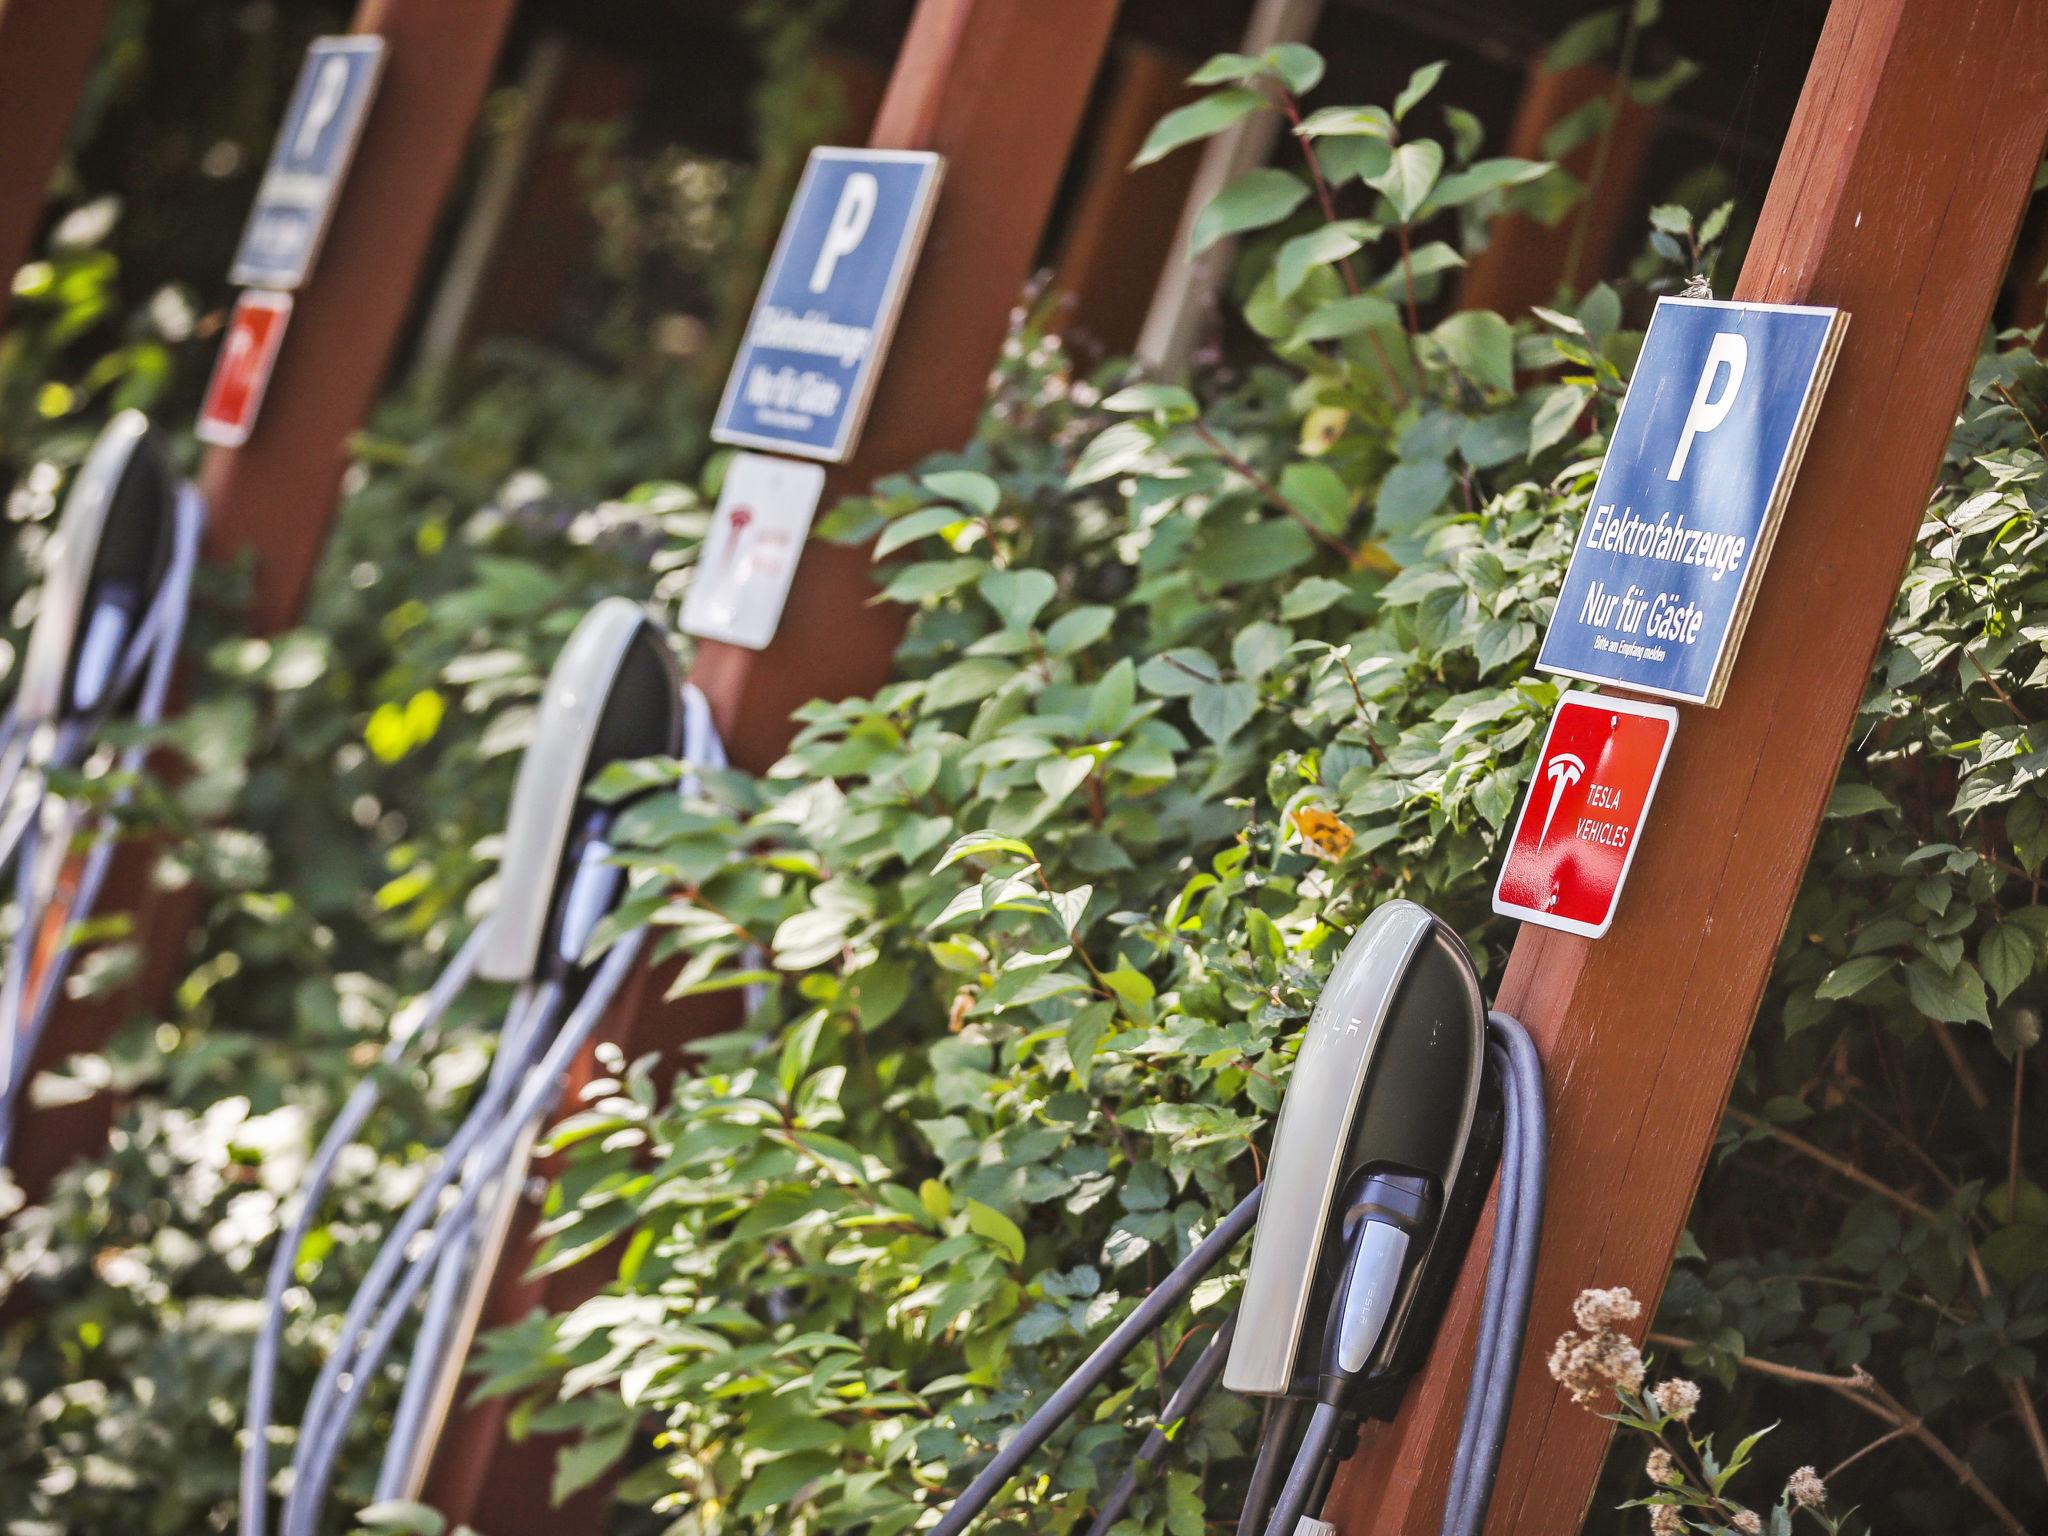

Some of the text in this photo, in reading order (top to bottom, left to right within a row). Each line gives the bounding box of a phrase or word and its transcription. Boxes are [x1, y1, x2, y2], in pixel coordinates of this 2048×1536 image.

[809, 172, 879, 294] P
[1666, 332, 1748, 482] P
[1586, 503, 1746, 582] Elektrofahrzeuge
[1578, 580, 1704, 645] Nur für Gäste
[1586, 783, 1621, 811] TESLA
[1576, 817, 1629, 848] VEHICLES
[1361, 1280, 1376, 1325] ESLA
